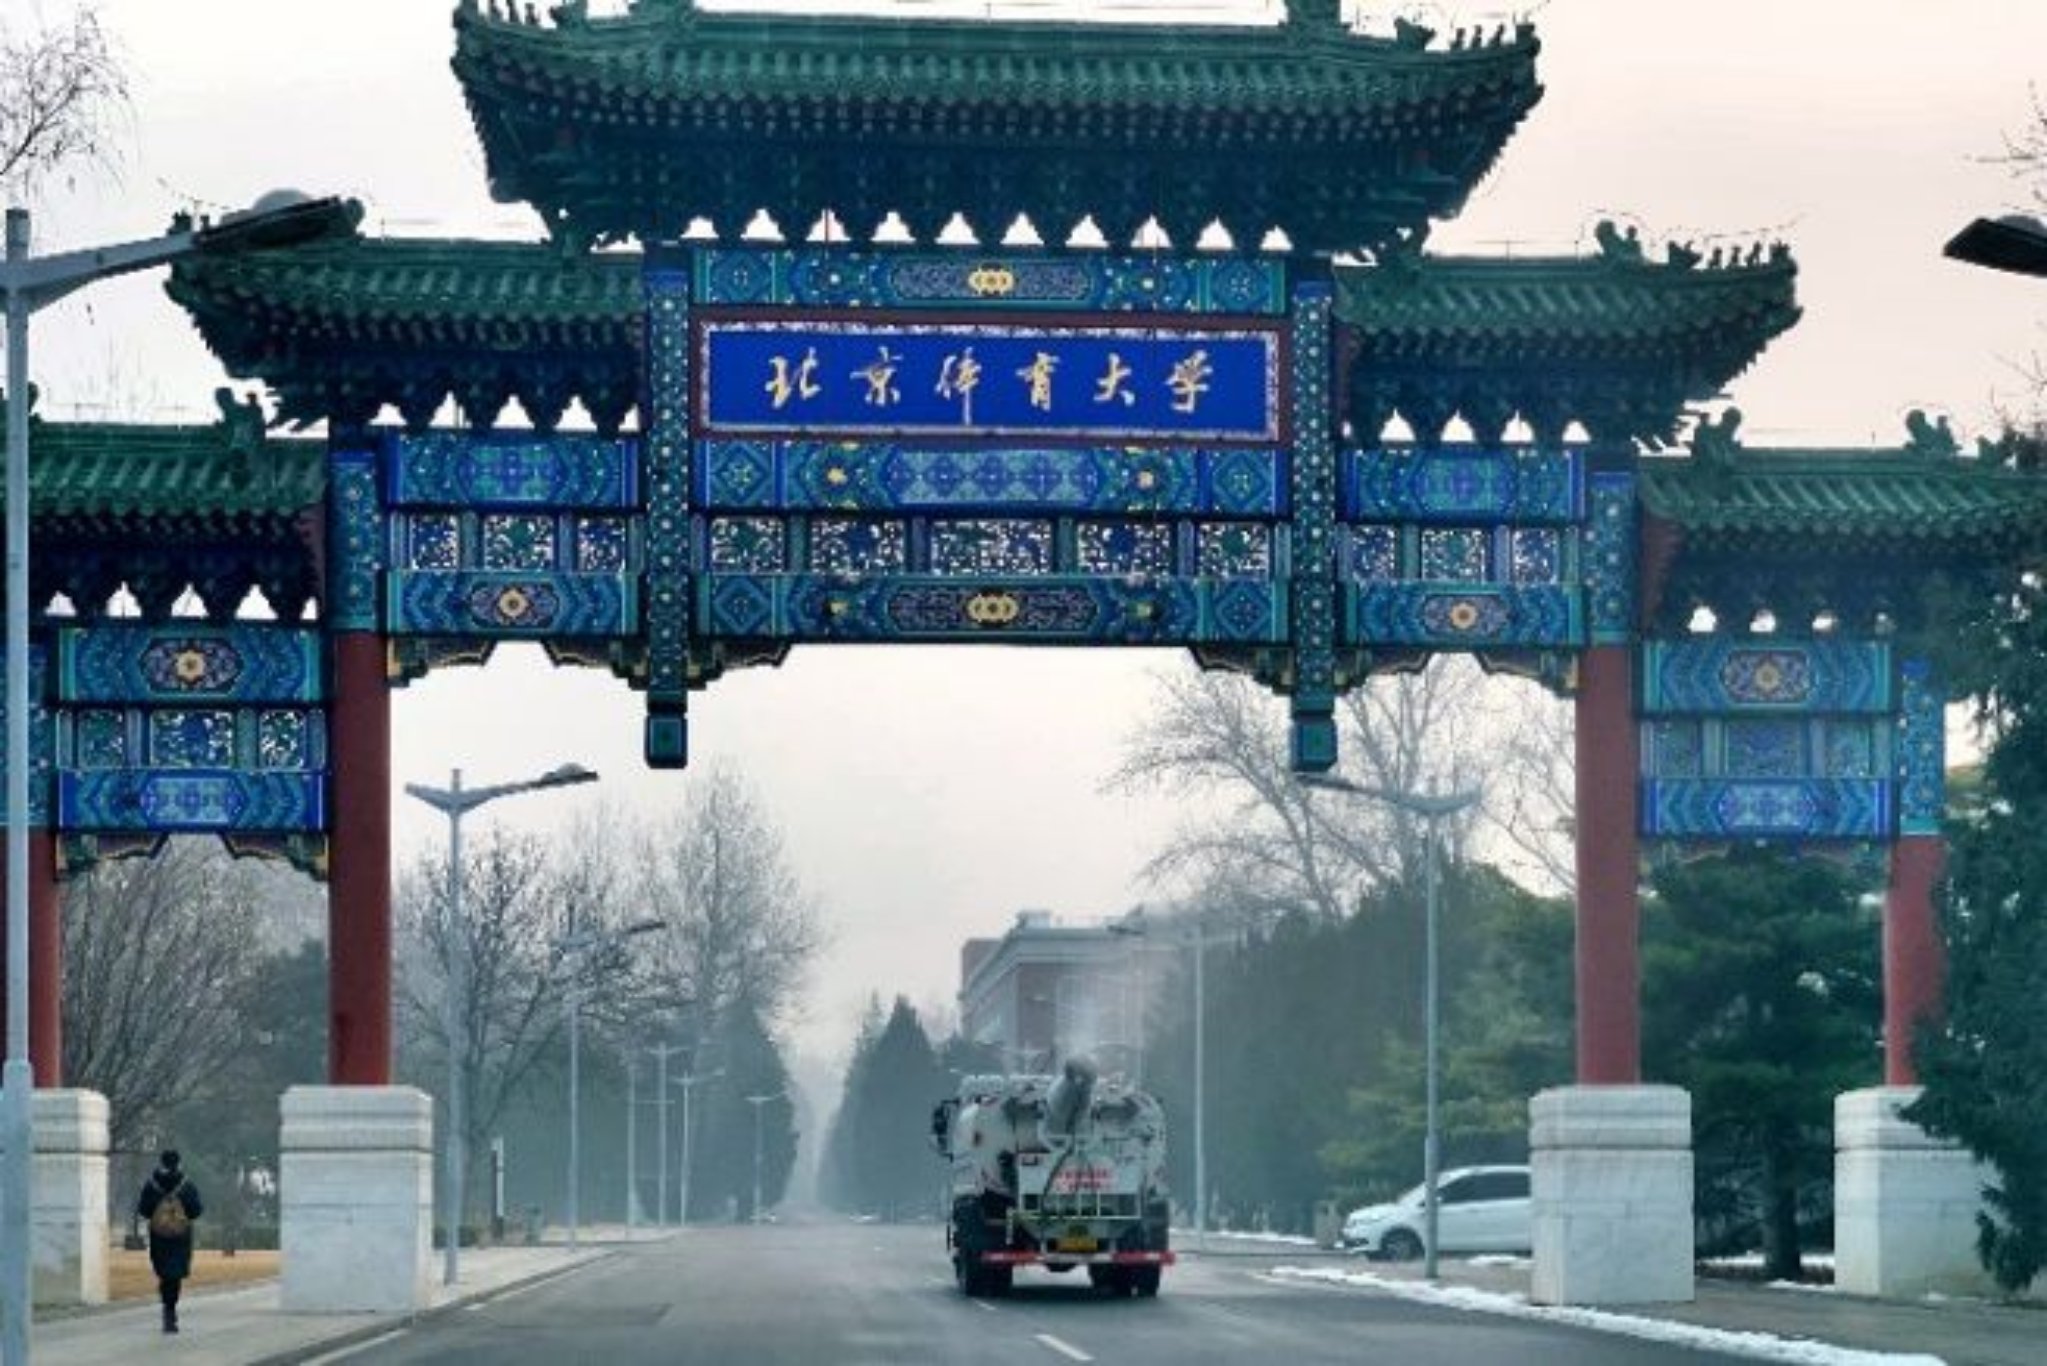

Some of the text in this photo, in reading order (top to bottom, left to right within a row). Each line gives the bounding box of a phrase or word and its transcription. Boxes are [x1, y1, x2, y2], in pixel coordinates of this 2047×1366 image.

[764, 347, 1214, 424] 北京体育大学
